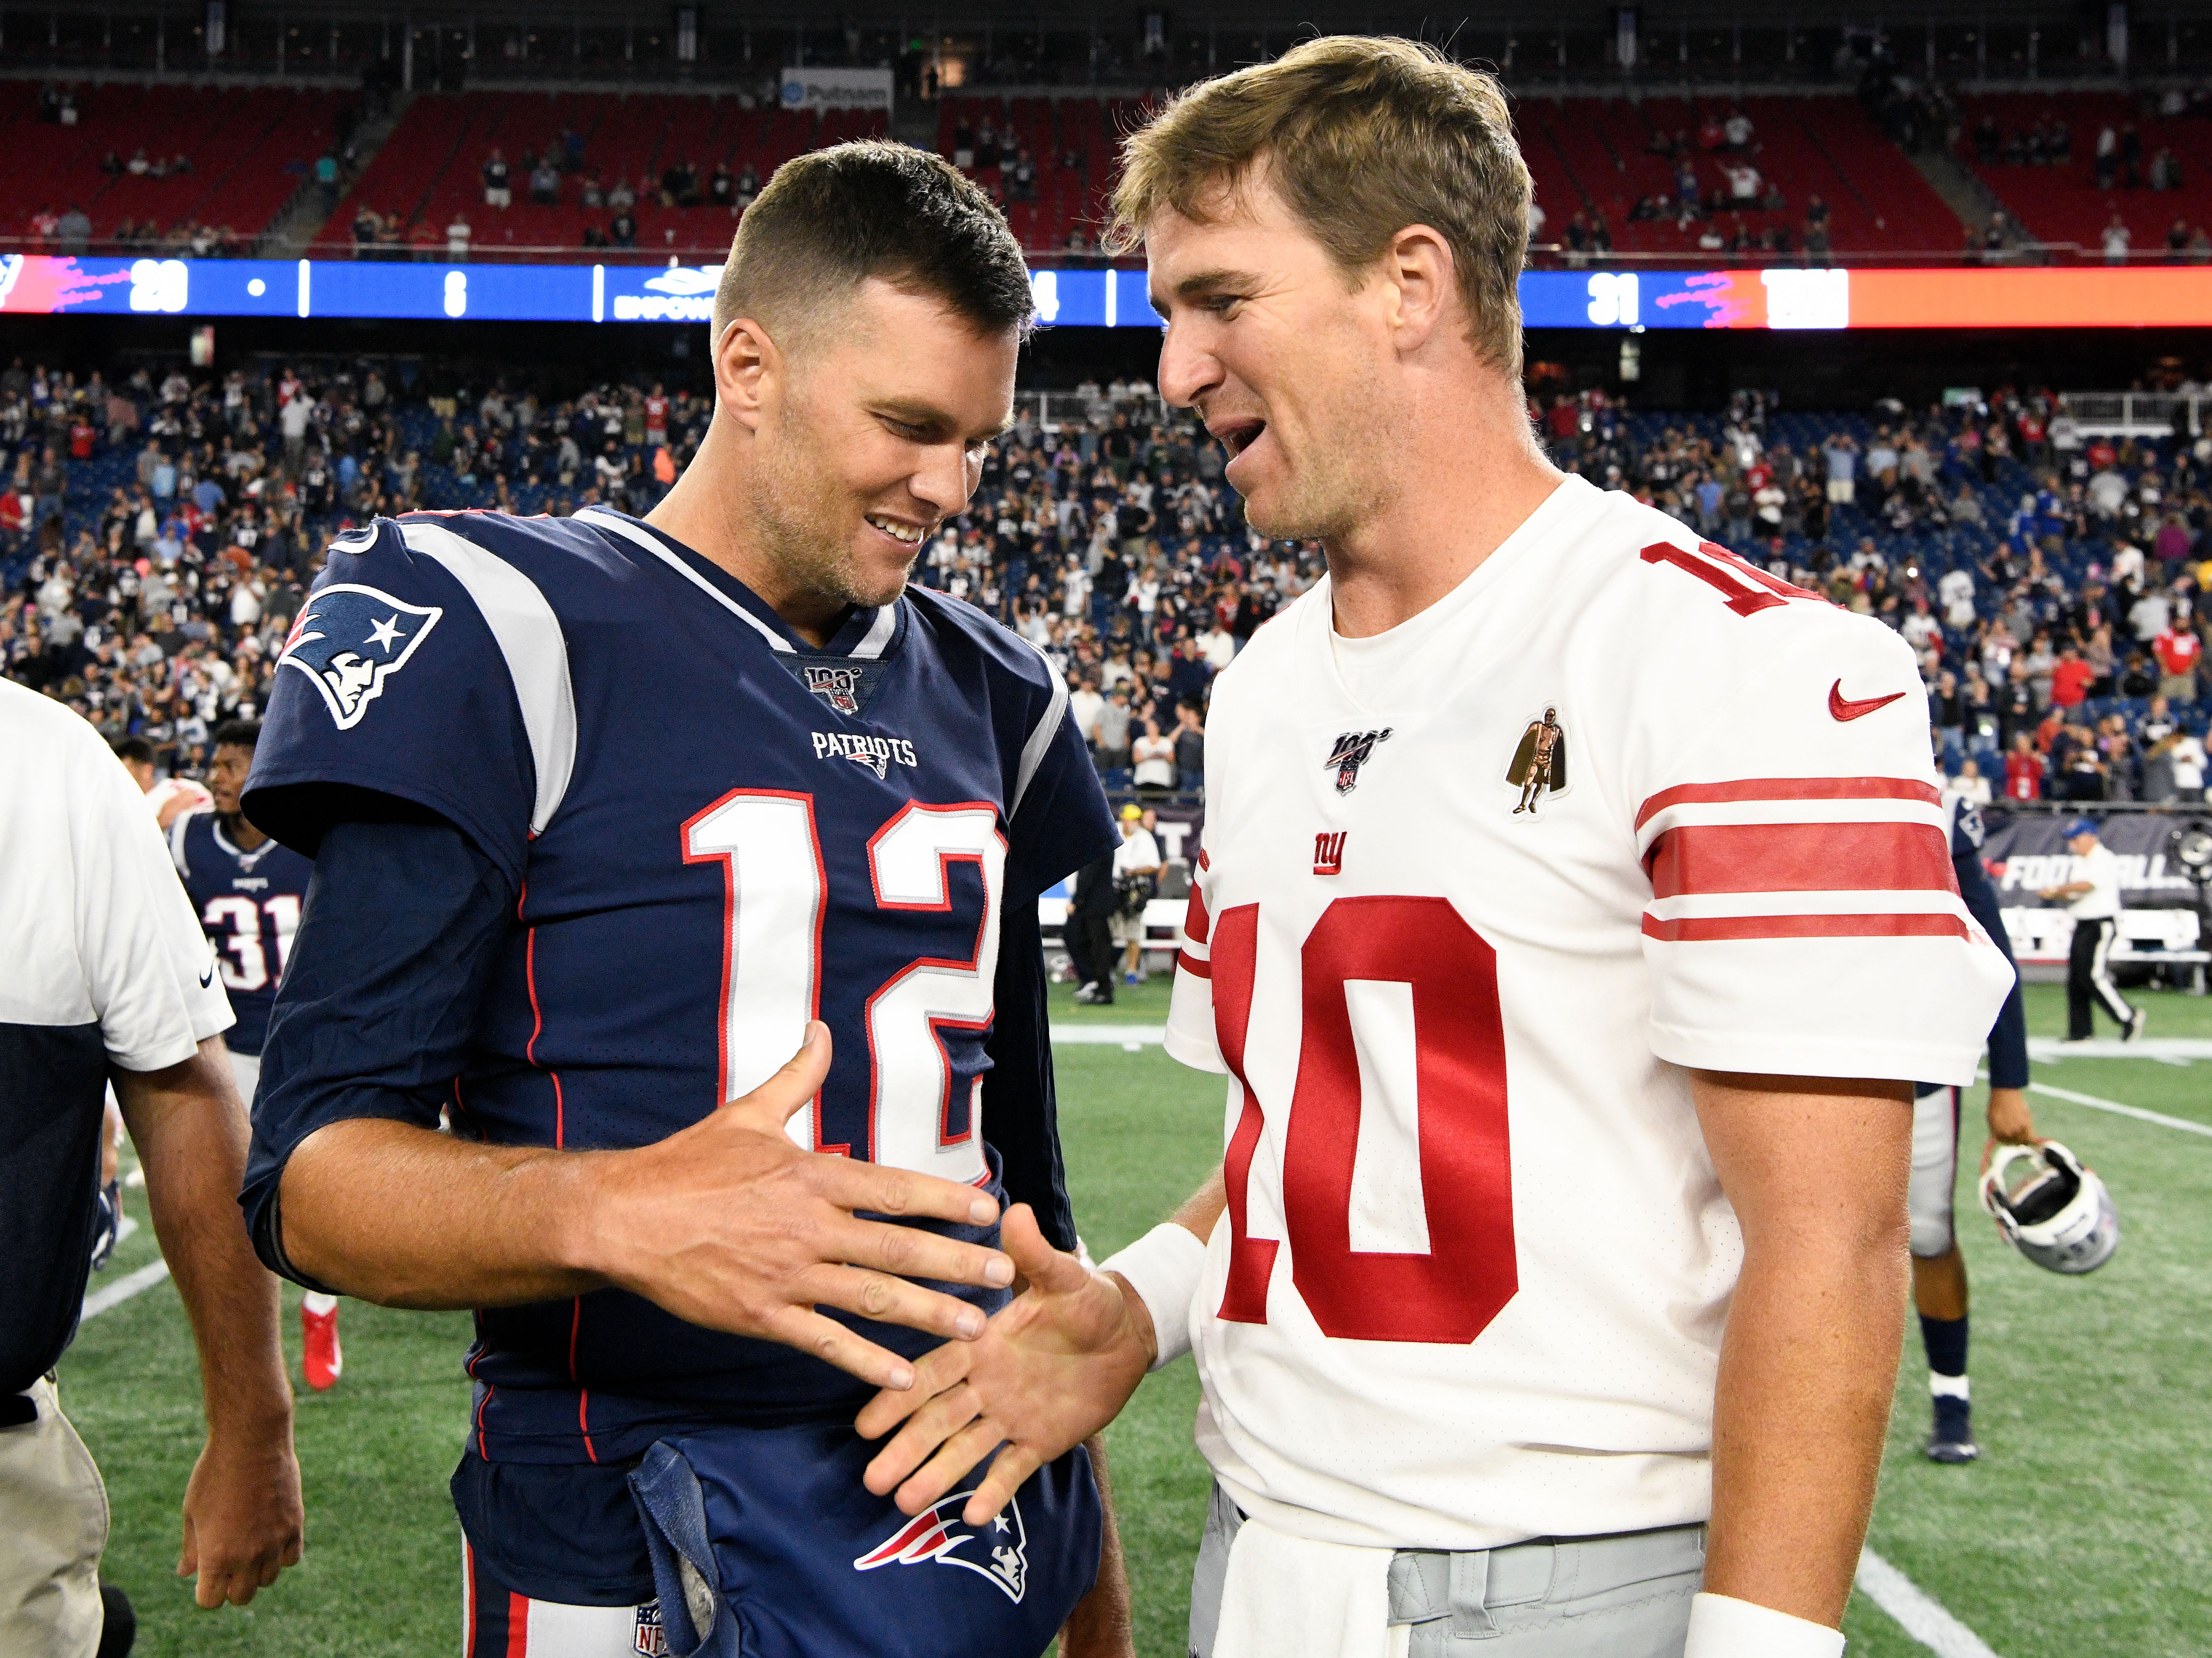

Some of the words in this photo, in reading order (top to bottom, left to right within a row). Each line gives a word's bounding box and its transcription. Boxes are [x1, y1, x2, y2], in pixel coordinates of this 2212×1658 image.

[811, 732, 918, 767] PATRIOTS
[203, 893, 301, 991] 31
[680, 788, 1008, 1188] 12
[1210, 895, 1519, 1344] 10
[638, 1626, 668, 1654] NF
